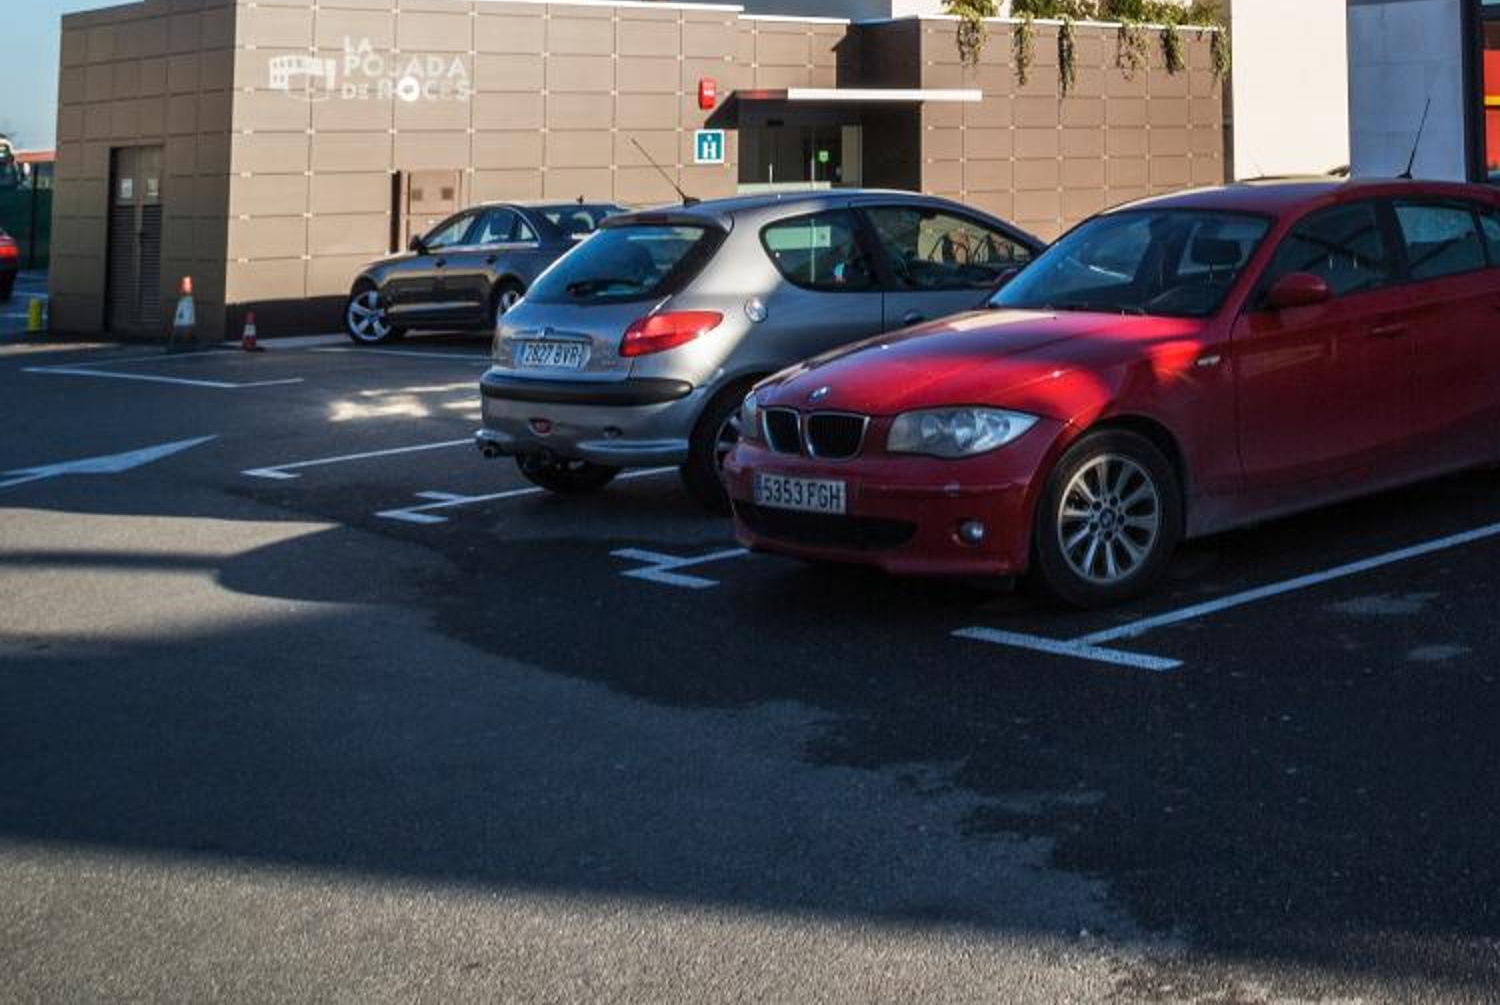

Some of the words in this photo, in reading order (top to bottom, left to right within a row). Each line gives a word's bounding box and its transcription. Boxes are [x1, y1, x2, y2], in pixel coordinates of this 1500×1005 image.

[344, 35, 372, 53] LA
[341, 82, 369, 100] DE
[763, 477, 803, 505] 5353
[807, 482, 841, 510] FGH
